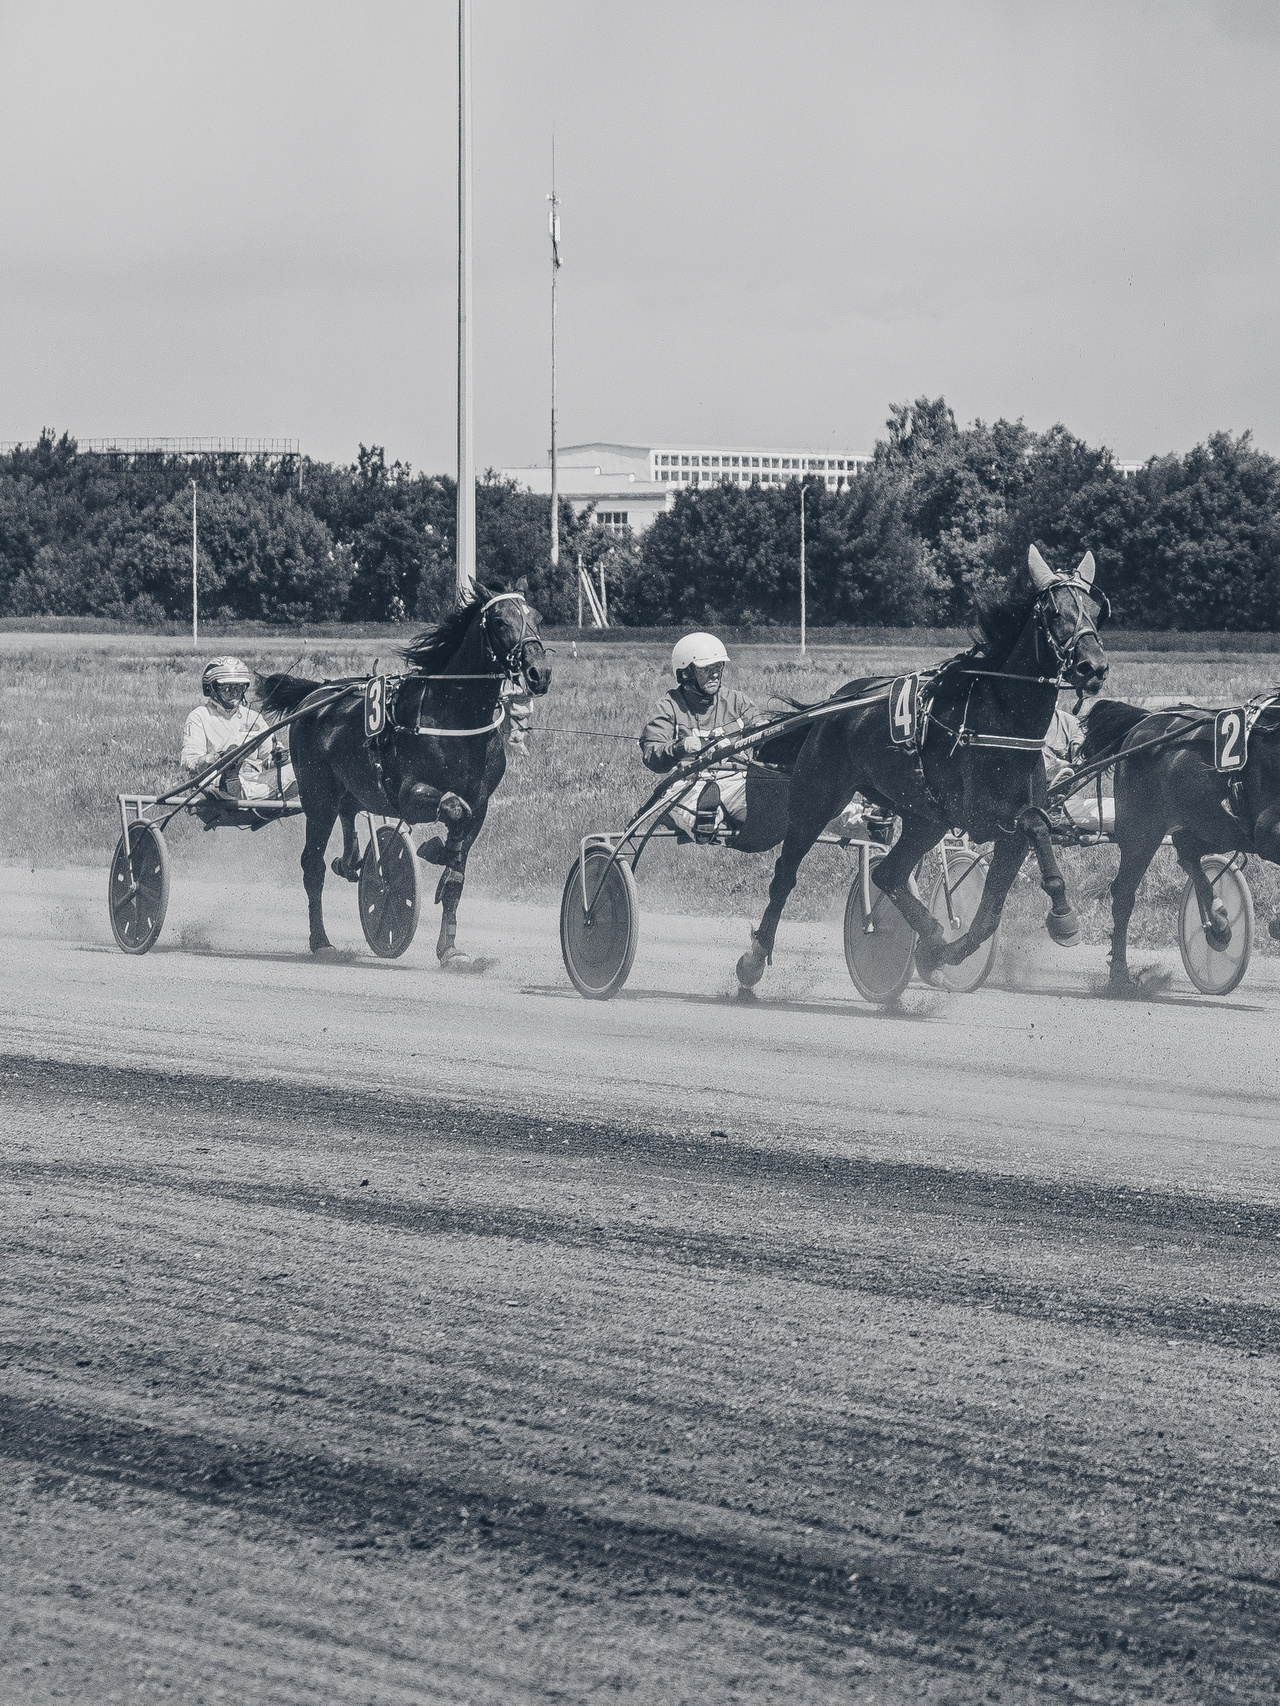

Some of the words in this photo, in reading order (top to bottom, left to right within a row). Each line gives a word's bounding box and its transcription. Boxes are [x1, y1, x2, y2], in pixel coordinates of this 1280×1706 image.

[369, 681, 381, 731] 3
[894, 679, 912, 736] 4
[1221, 713, 1241, 768] 2
